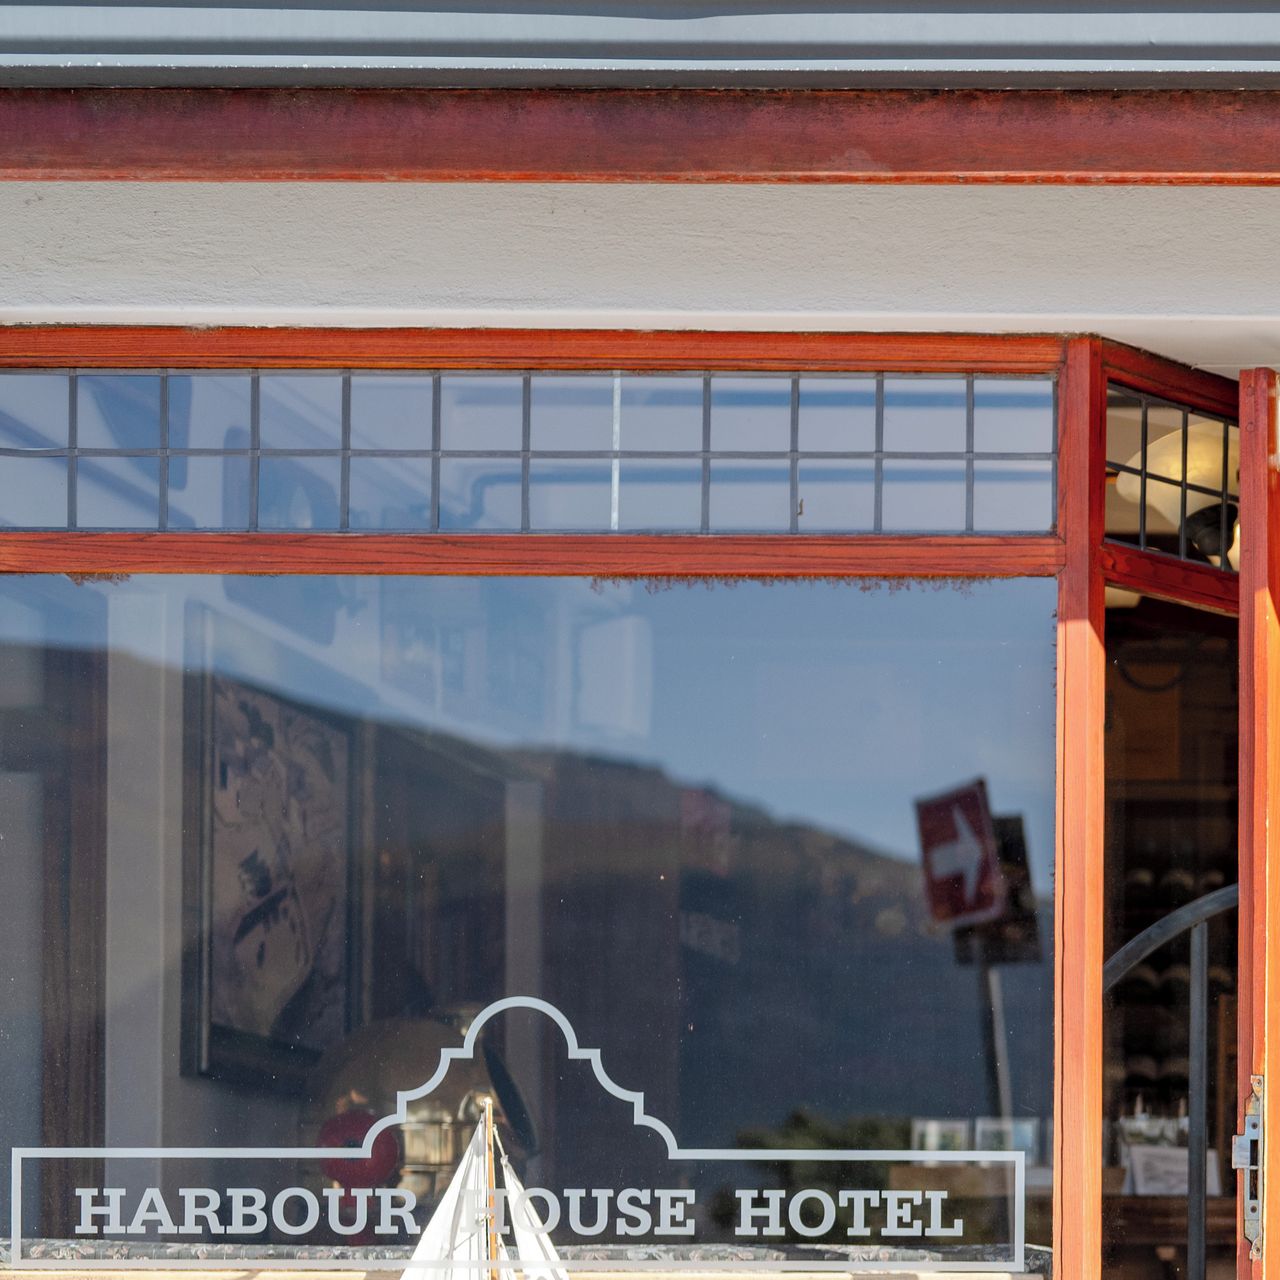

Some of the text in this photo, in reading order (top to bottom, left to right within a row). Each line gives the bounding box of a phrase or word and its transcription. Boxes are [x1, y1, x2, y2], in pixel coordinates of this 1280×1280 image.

[76, 1187, 963, 1237] HARBOUR HOUSE HOTEL
